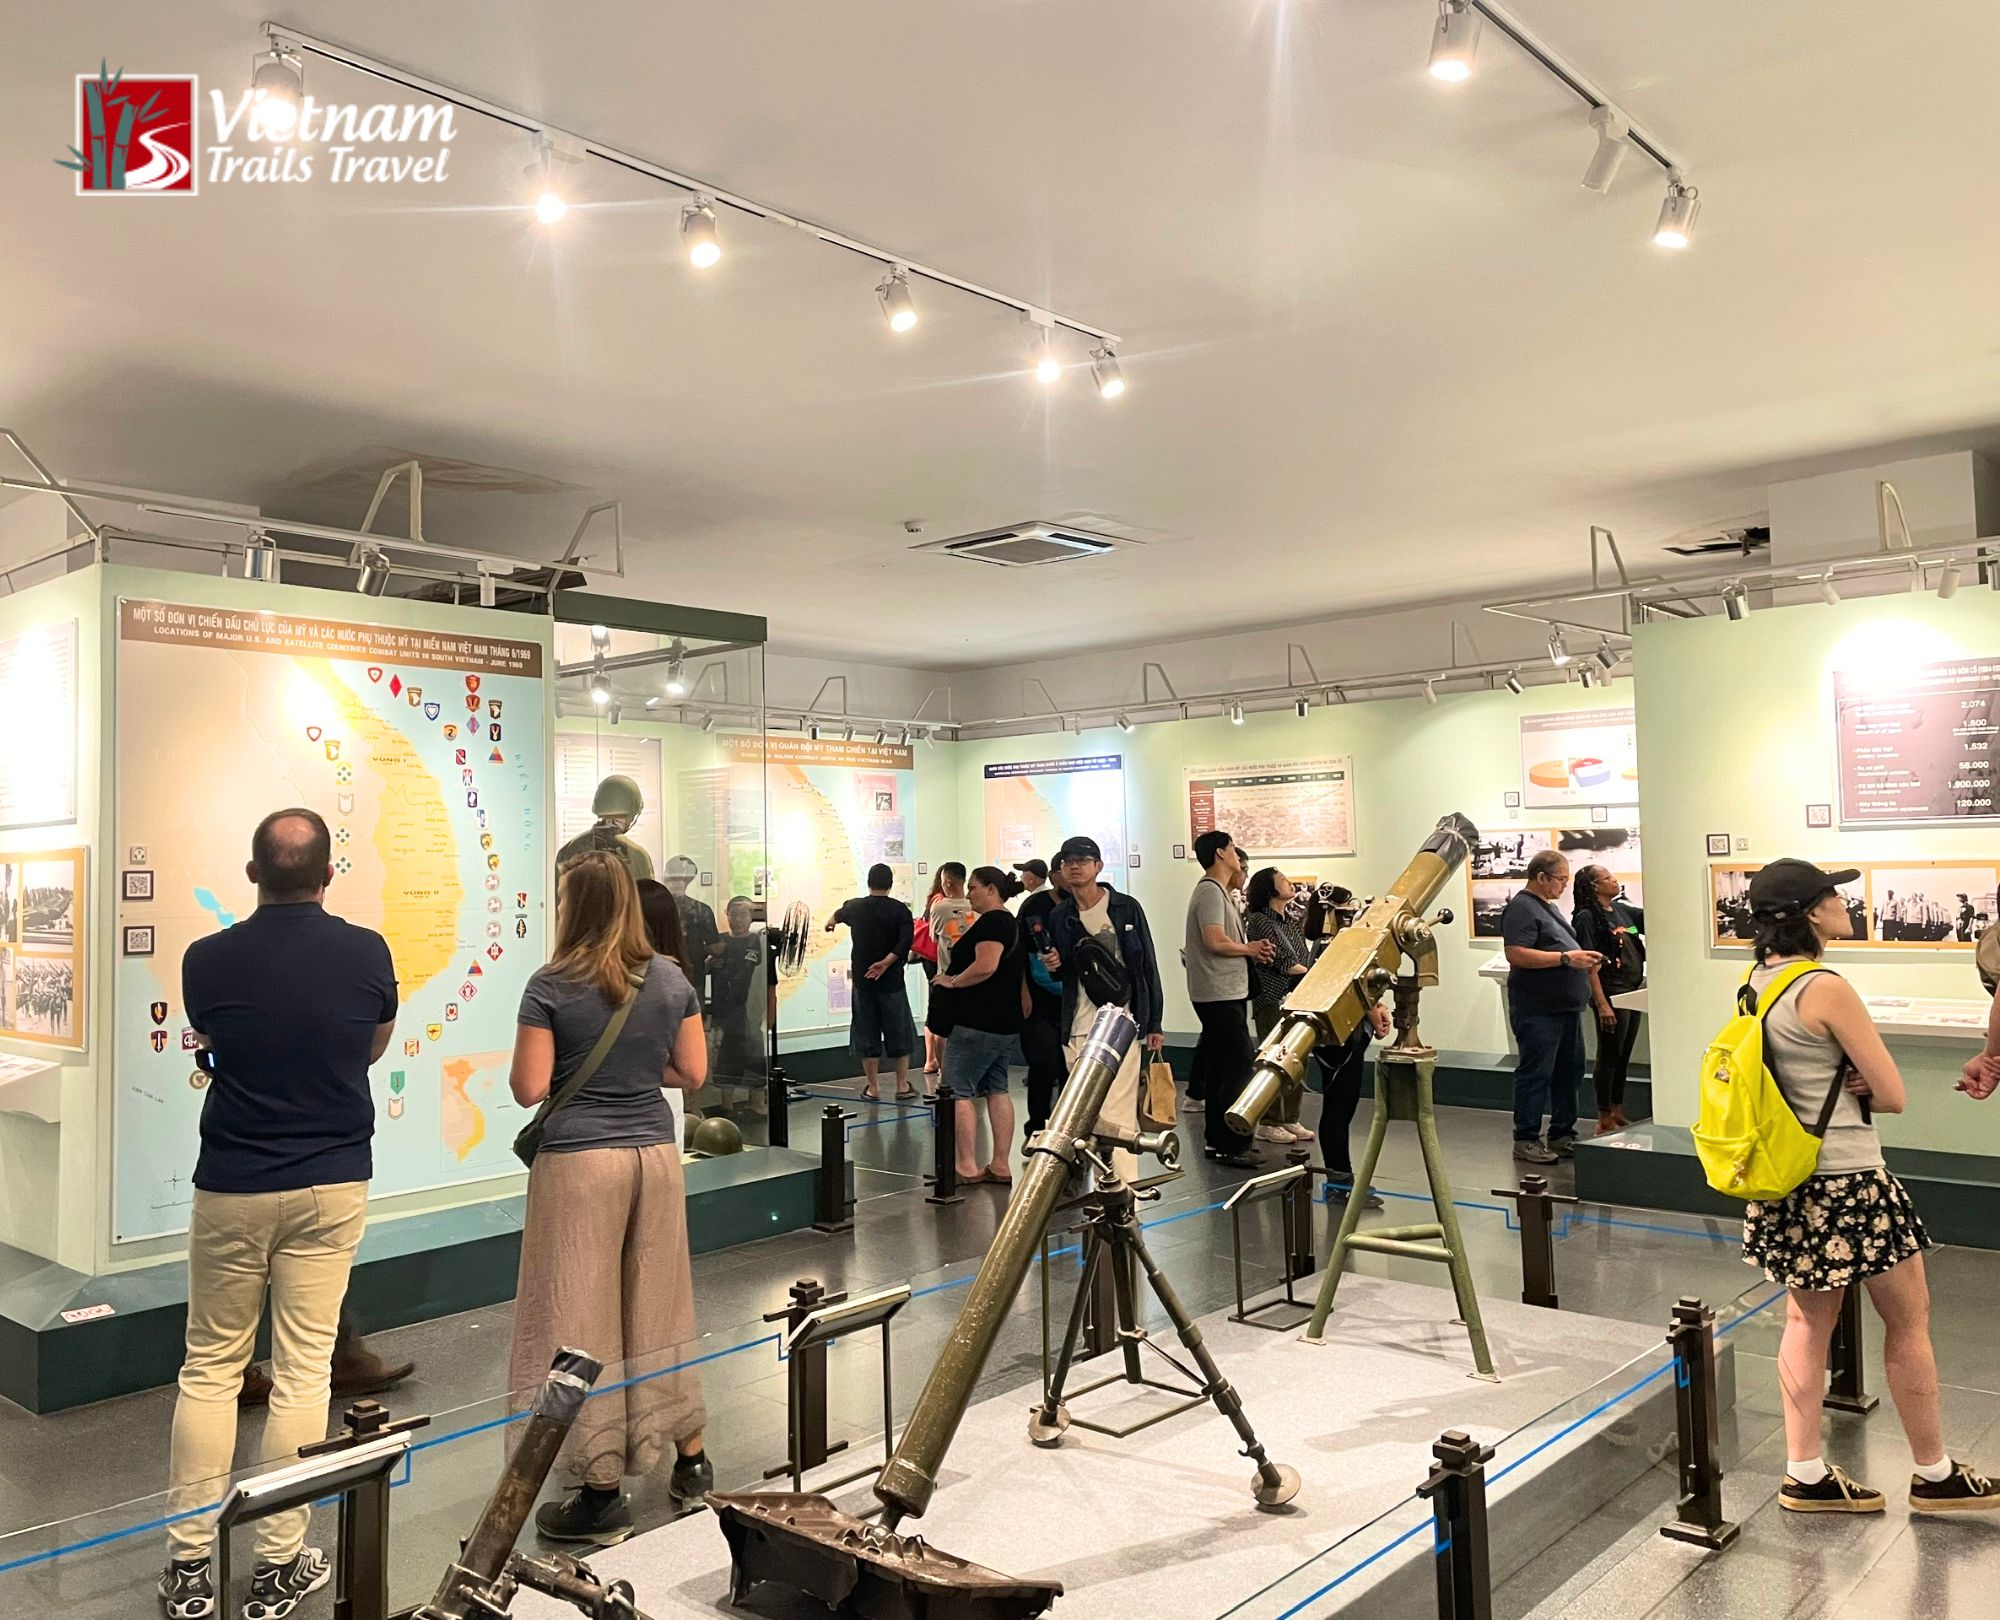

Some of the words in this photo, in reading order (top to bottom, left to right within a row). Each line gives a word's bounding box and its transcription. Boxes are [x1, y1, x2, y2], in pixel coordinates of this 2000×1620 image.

[133, 606, 151, 623] MỘT
[154, 606, 166, 622] SỐ
[187, 614, 196, 628] VỊ
[198, 612, 222, 628] CHIẾN
[243, 617, 259, 632] CHỦ
[261, 620, 275, 635] LỰC
[278, 620, 293, 635] CỦA
[295, 623, 306, 637] MỸ
[308, 625, 319, 638] VÀ
[320, 626, 335, 640] CÁC
[337, 628, 356, 642] NƯỚC
[357, 631, 373, 646] PHỤ
[374, 632, 396, 647] THUỘC
[398, 634, 409, 647] MỸ
[410, 637, 421, 650] TẠI
[441, 640, 457, 652] NAM
[458, 640, 473, 655] VIỆT
[474, 645, 488, 656] NAM
[489, 644, 510, 658] THÁNG
[154, 626, 200, 638] LOCATIONS
[202, 630, 213, 639] OF
[215, 631, 243, 641] MAJOR
[246, 635, 263, 644] U.S.
[265, 636, 282, 645] AND
[285, 638, 325, 650] SATELLITE
[326, 642, 367, 654] COUNTRIES
[369, 646, 398, 657] COMBAT
[399, 650, 420, 659] UNITS
[421, 652, 430, 660] IN
[431, 653, 453, 662] SOUTH
[455, 655, 484, 665] VIETNAM
[490, 659, 506, 668] JUNE
[1961, 700, 1985, 709] 2.074
[825, 744, 845, 753] THAM
[878, 747, 893, 757] VIỆT
[894, 749, 908, 757] NAM
[1956, 799, 1991, 807] 120.000
